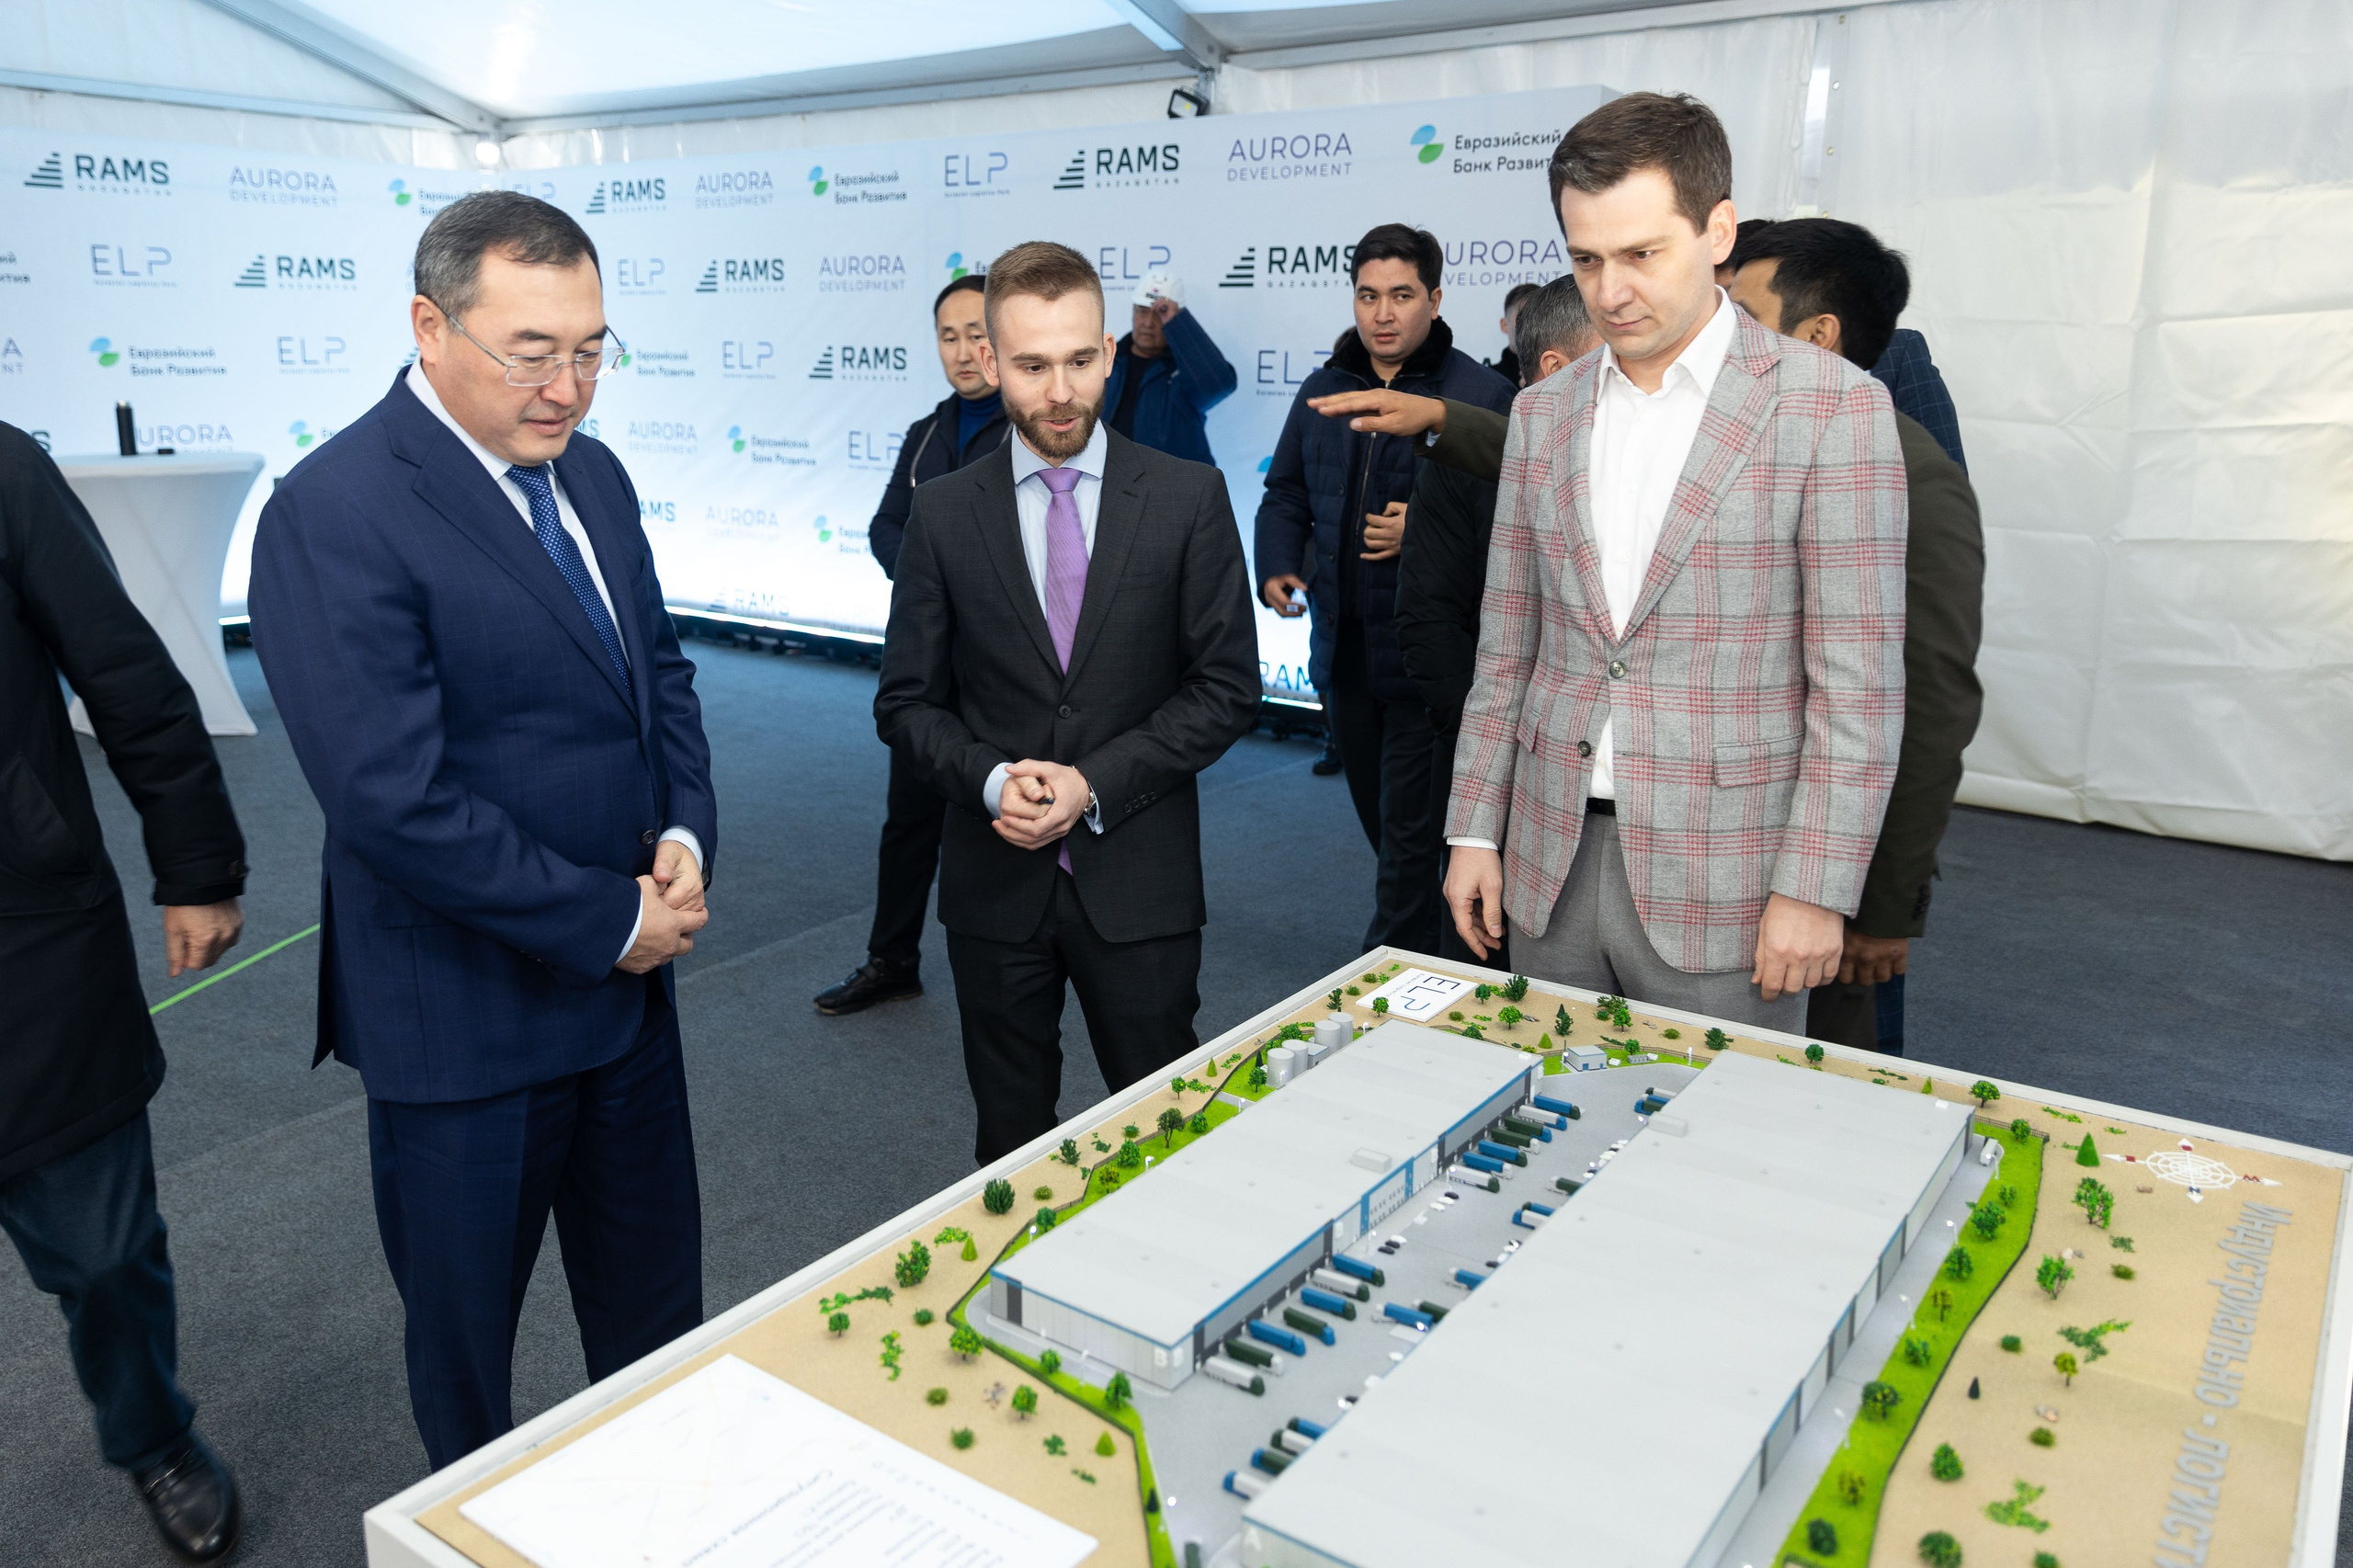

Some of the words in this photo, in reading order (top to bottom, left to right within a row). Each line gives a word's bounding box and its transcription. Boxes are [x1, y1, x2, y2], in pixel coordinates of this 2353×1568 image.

[1228, 132, 1353, 163] AURORA
[1455, 129, 1562, 153] Евразийский
[74, 153, 169, 185] RAMS
[944, 152, 1008, 187] ELP
[1096, 144, 1180, 175] RAMS
[1453, 158, 1492, 174] Банк
[1496, 155, 1553, 171] Развит
[231, 166, 337, 193] AURORA
[696, 171, 774, 194] AURORA
[1227, 162, 1353, 182] DEVELOPMENT
[231, 190, 337, 208] DEVELOPMENT
[611, 178, 665, 202] RAMS
[835, 191, 858, 205] Банк
[91, 244, 172, 277] ELP
[1099, 245, 1171, 279] ELP
[1445, 239, 1563, 266] URORA
[277, 255, 357, 280] RAMS
[618, 258, 665, 287] ELP
[724, 258, 785, 282] RAMS
[818, 256, 906, 278] AURORA
[1443, 270, 1563, 287] VELOPMENT
[818, 278, 906, 294] DEVELOPMENT
[277, 336, 347, 366] ELP
[722, 341, 774, 369] ELP
[841, 346, 908, 370] RAMS
[137, 424, 233, 447] URORA
[627, 420, 698, 442] AURORA
[640, 500, 676, 523] AMS
[706, 506, 780, 528] AURORA
[1259, 662, 1318, 693] RAM
[2194, 1201, 2293, 1409] Индустриально
